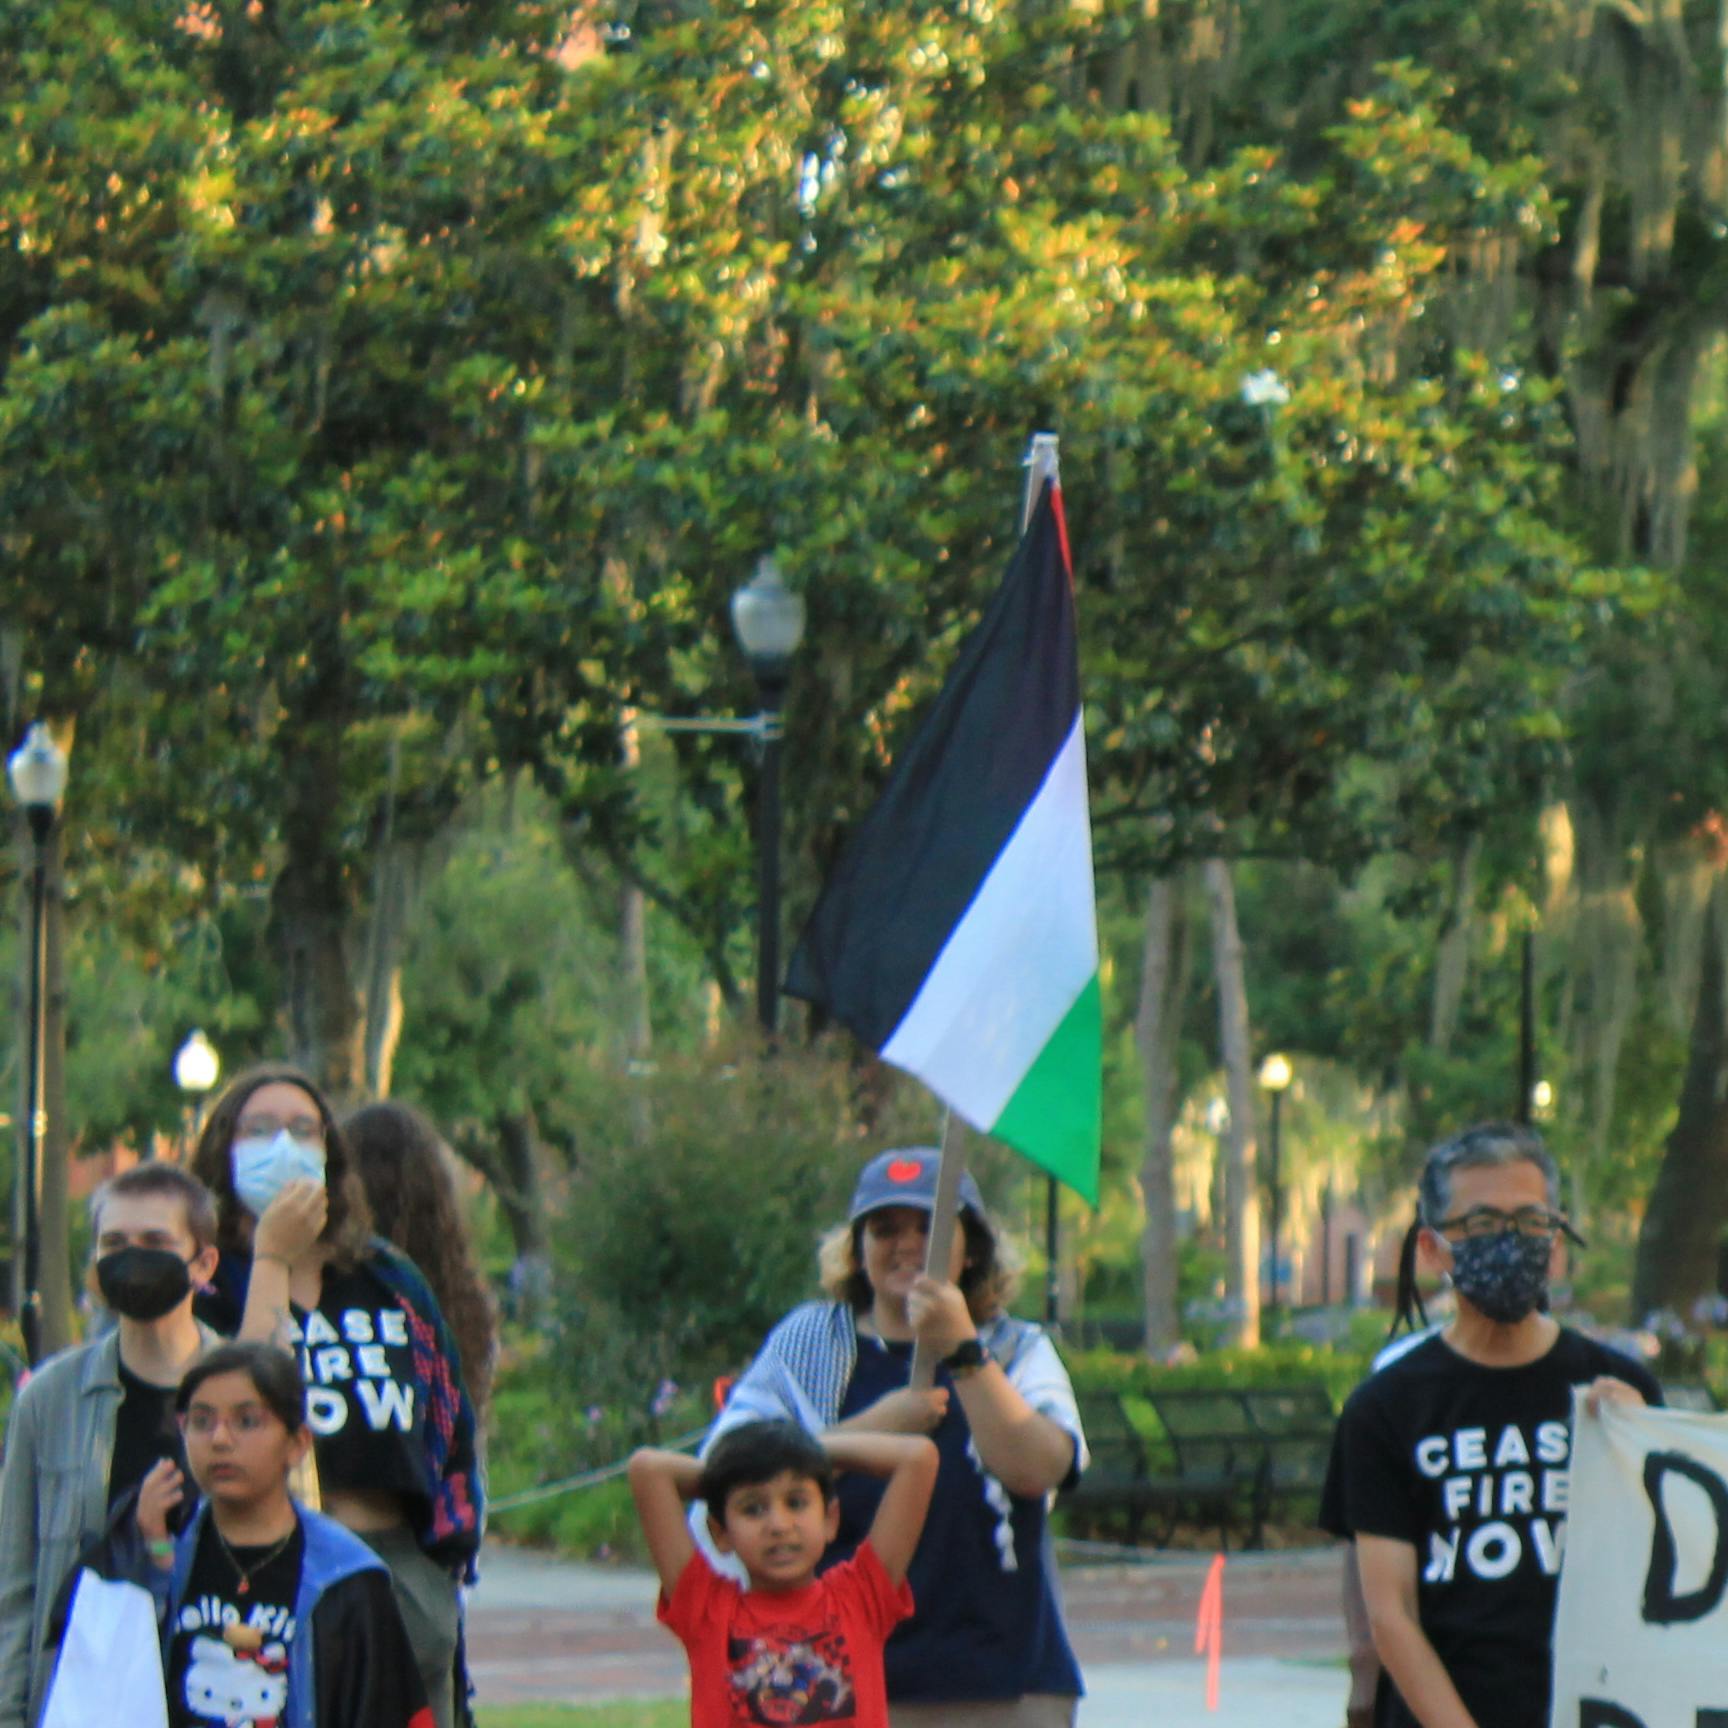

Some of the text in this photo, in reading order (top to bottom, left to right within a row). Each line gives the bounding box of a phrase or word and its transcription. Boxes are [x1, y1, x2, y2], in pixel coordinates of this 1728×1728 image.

[288, 1308, 409, 1346] ASE
[301, 1345, 391, 1383] IRE
[303, 1378, 416, 1436] OW
[1413, 1420, 1572, 1479] CEAS
[1441, 1470, 1570, 1522] FIRE
[174, 1594, 242, 1635] ello
